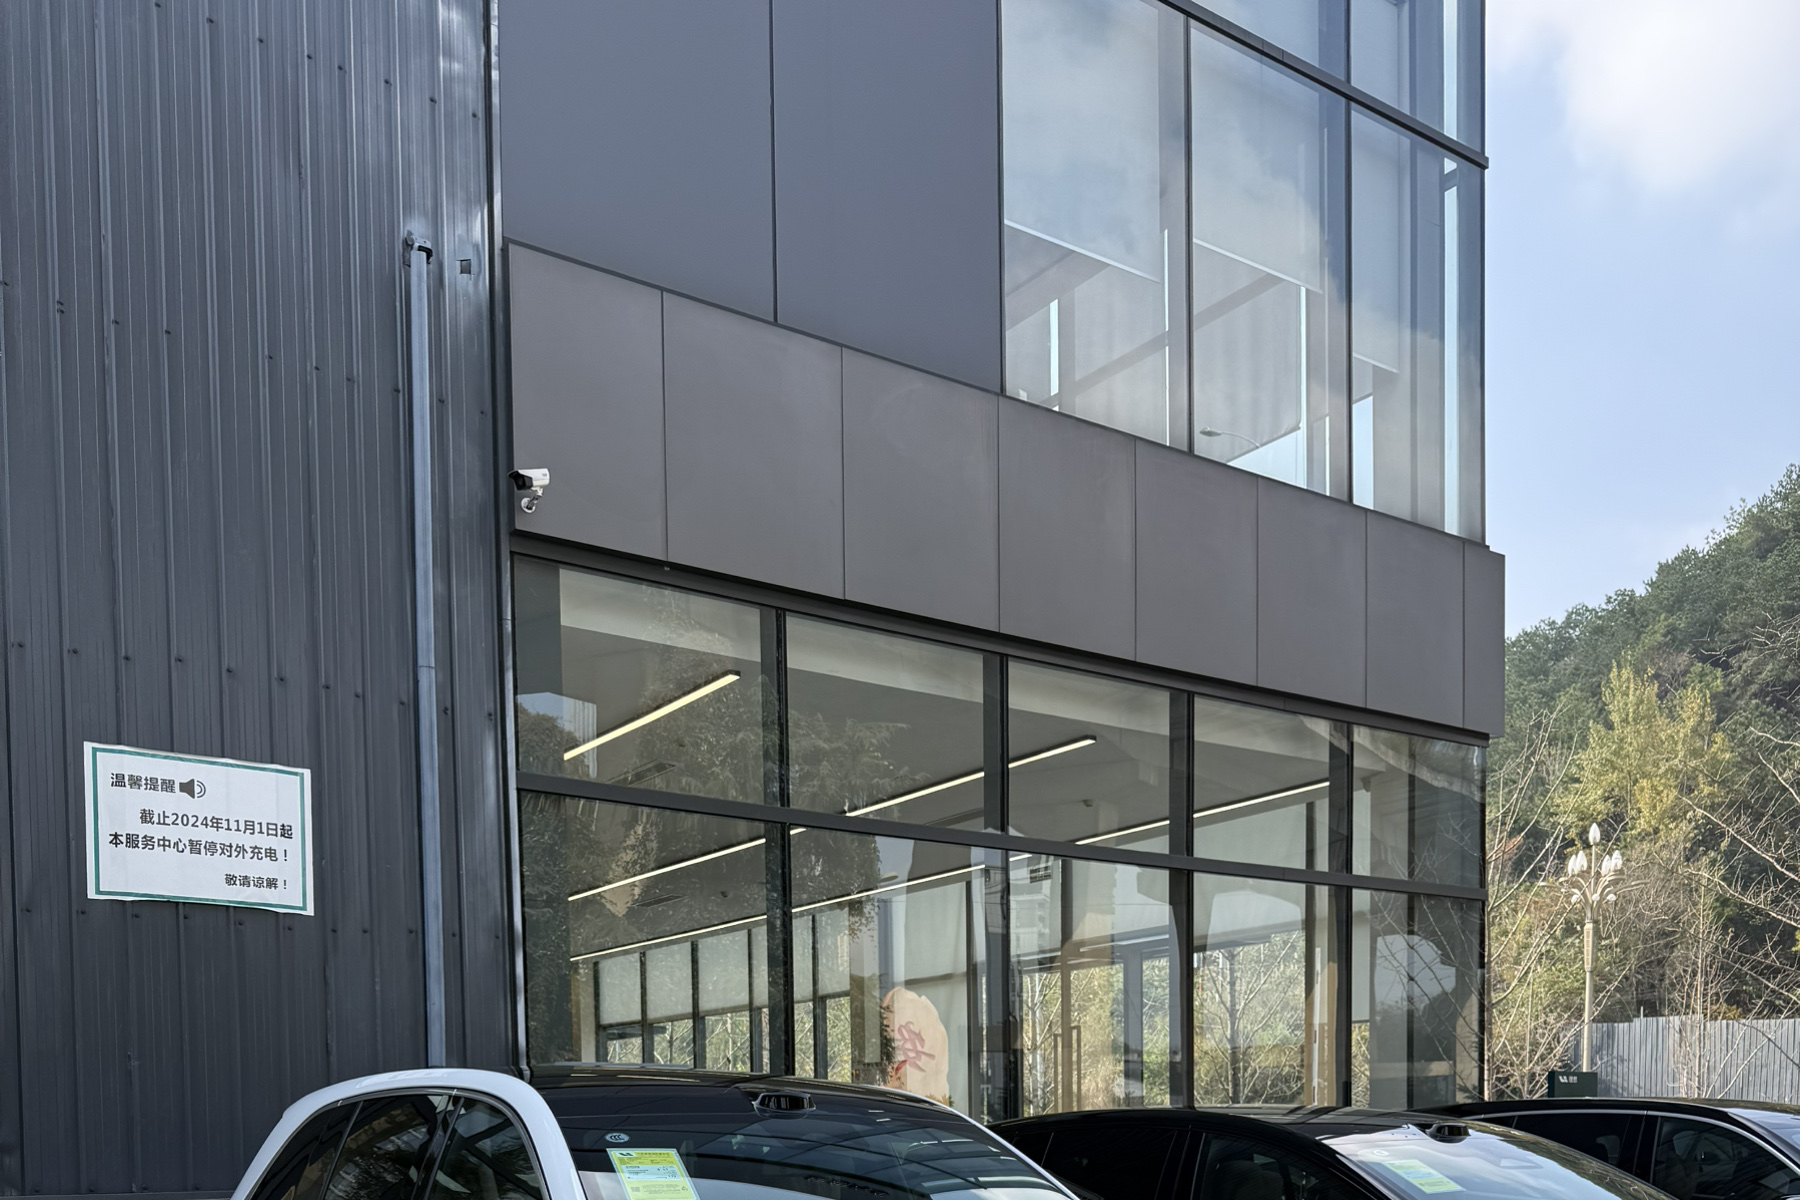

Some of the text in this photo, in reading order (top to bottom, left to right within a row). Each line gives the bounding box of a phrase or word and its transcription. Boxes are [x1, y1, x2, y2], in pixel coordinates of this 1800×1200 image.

[110, 772, 177, 794] 温馨提醒
[139, 808, 294, 840] 截止2024年11月1日起
[108, 831, 289, 862] 本服务中心暂停对外充电！
[224, 873, 288, 890] 敬请谅解！
